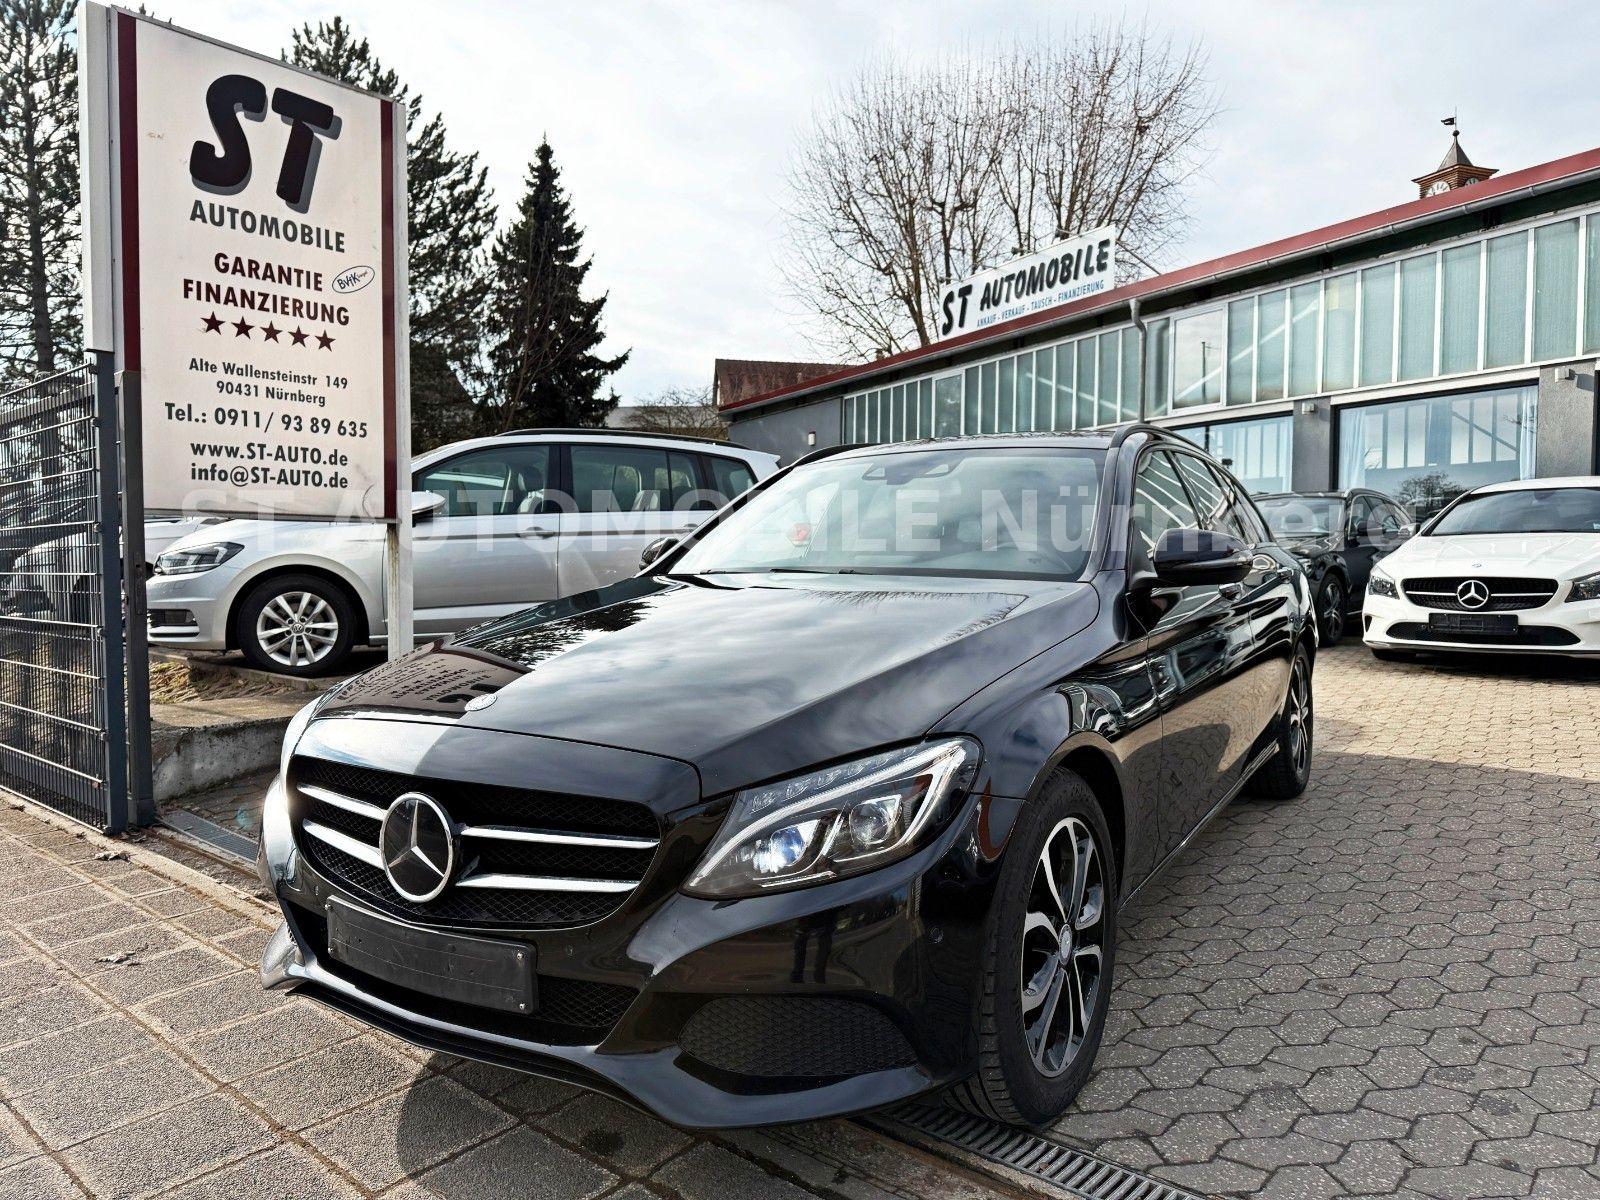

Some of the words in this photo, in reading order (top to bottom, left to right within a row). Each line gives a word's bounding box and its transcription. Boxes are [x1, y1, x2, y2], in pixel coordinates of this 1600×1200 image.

[189, 74, 342, 214] ST
[189, 199, 345, 253] AUTOMOBILE
[214, 253, 323, 292] GARANTIE
[942, 284, 972, 336] ST
[980, 239, 1111, 311] AUTOMOBILE
[184, 278, 350, 326] FINANZIERUNG
[1002, 304, 1025, 320] VERKAUF
[1031, 296, 1052, 311] TAUSCH
[1058, 279, 1104, 302] FINANZIERUNG
[189, 358, 217, 373] Alte
[222, 362, 317, 386] Wallensteinstr
[326, 375, 348, 389] 149
[216, 380, 259, 398] 90431
[266, 386, 326, 407] Nürnberg
[164, 402, 207, 424] Tel.:
[281, 414, 303, 432] 93
[310, 417, 330, 435] 89
[338, 420, 368, 438] 635
[190, 442, 348, 467] www.ST-AUTO.de
[190, 463, 348, 489] info@ST-AUTO.de
